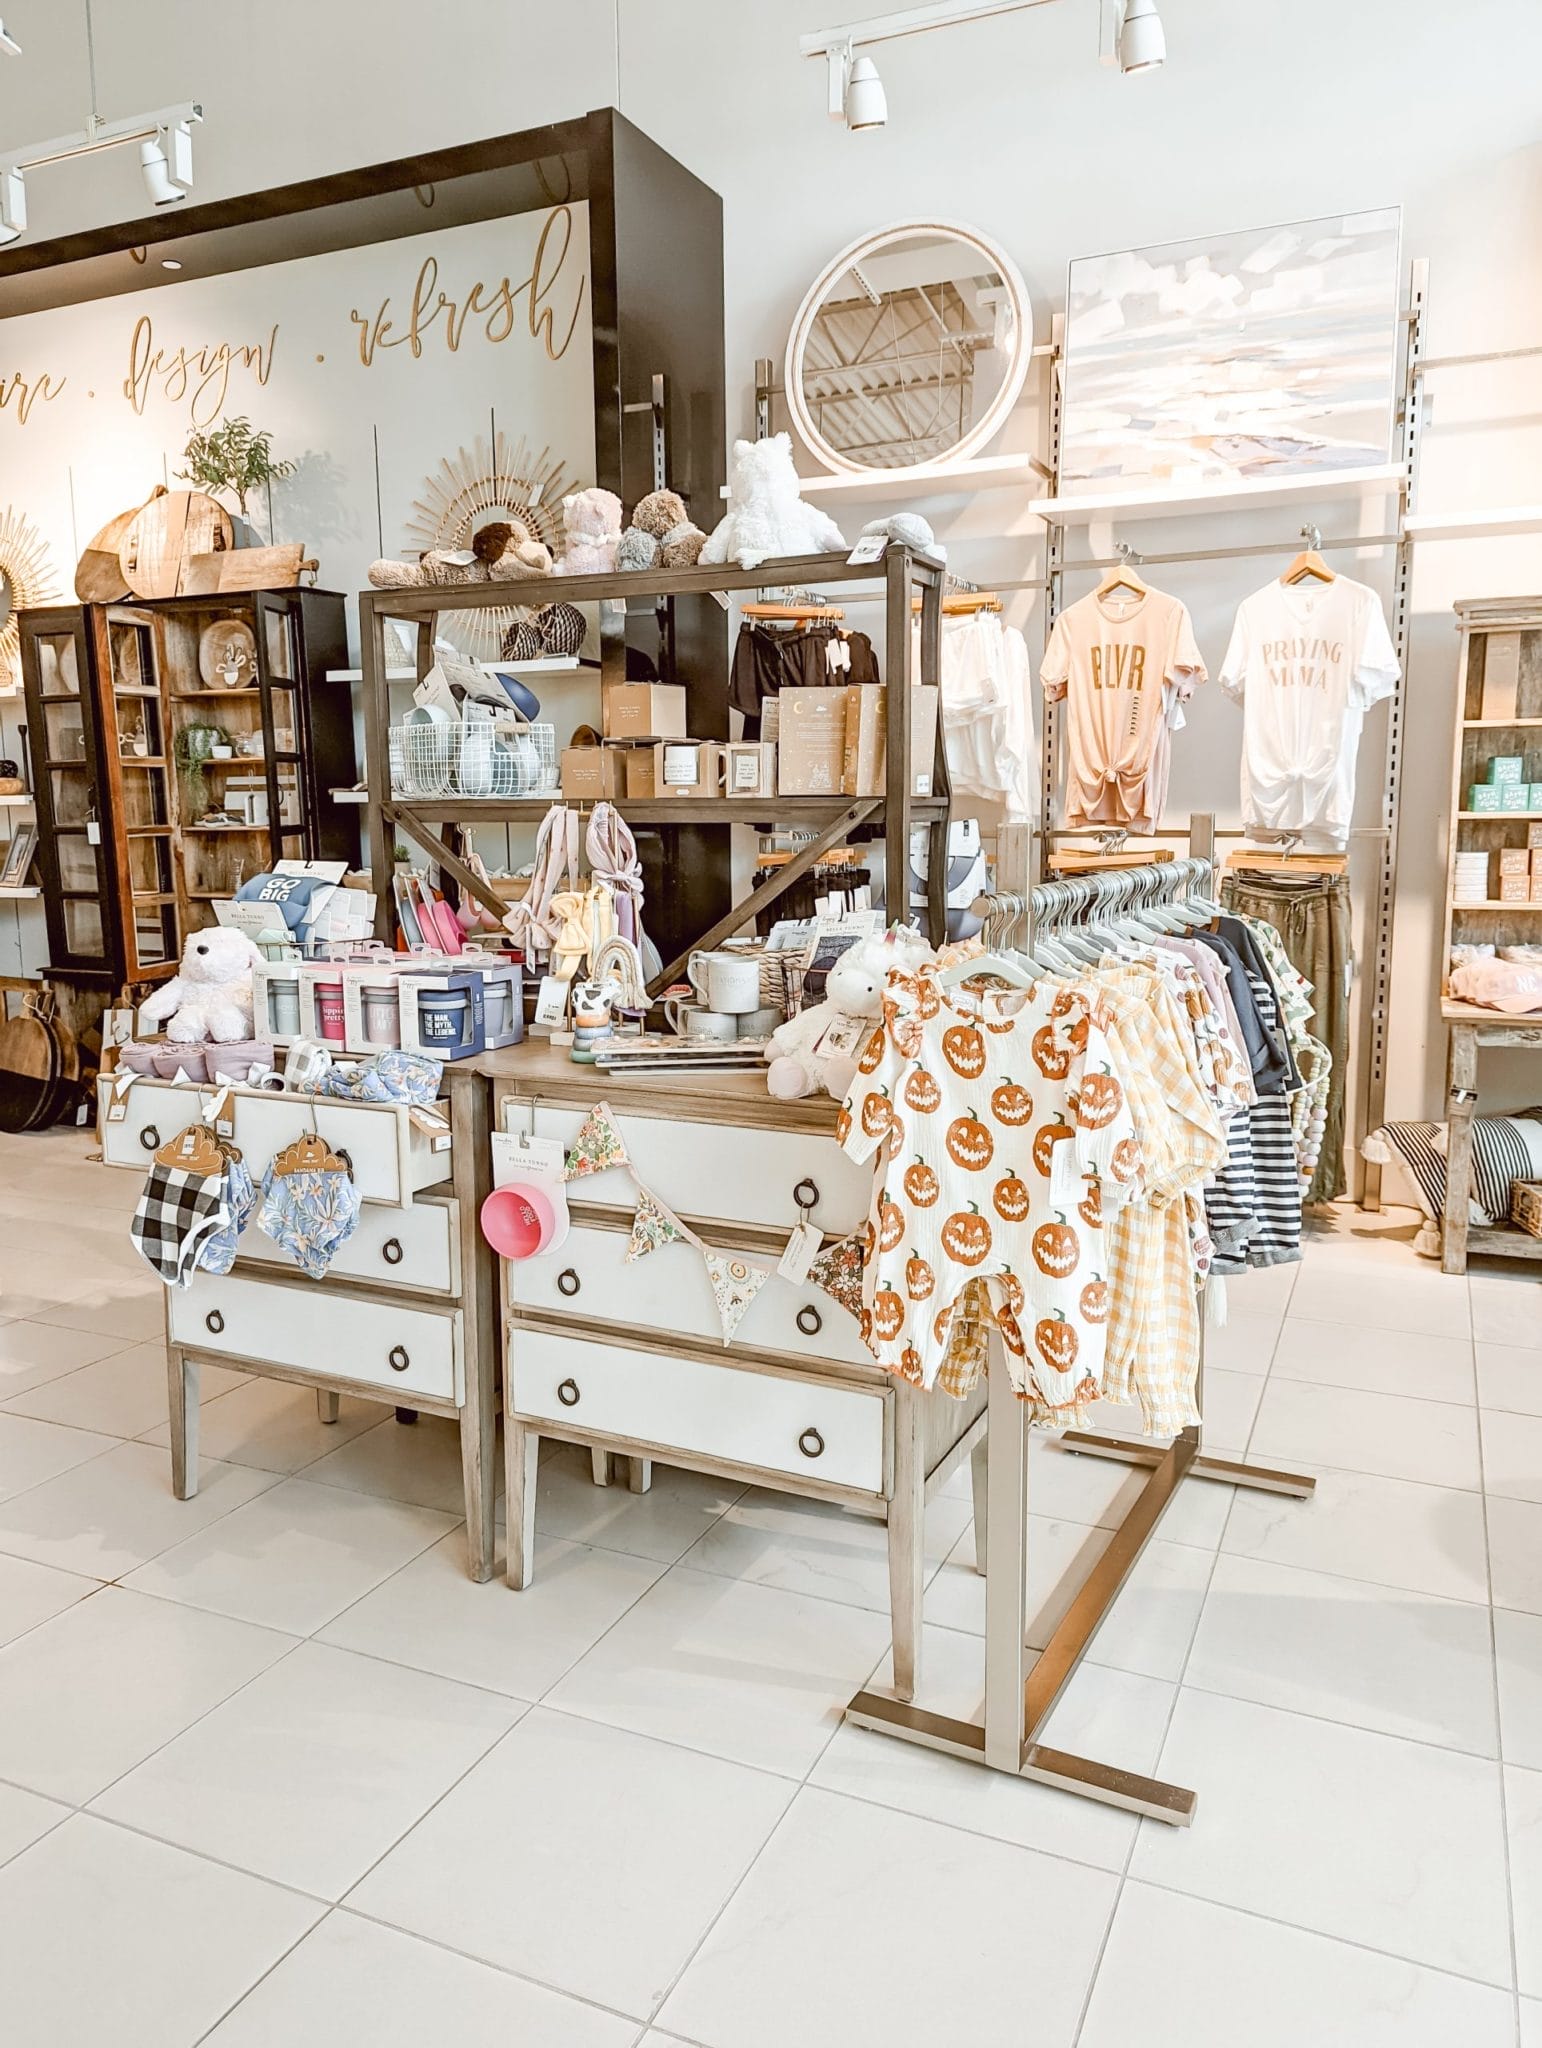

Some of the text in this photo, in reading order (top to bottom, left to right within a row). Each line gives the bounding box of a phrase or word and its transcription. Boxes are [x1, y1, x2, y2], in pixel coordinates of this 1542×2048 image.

[123, 316, 279, 427] design
[351, 206, 585, 367] refresh
[1262, 637, 1344, 665] PRAYING
[1090, 644, 1146, 691] BLVR
[258, 888, 291, 902] BIG
[266, 878, 301, 890] GO
